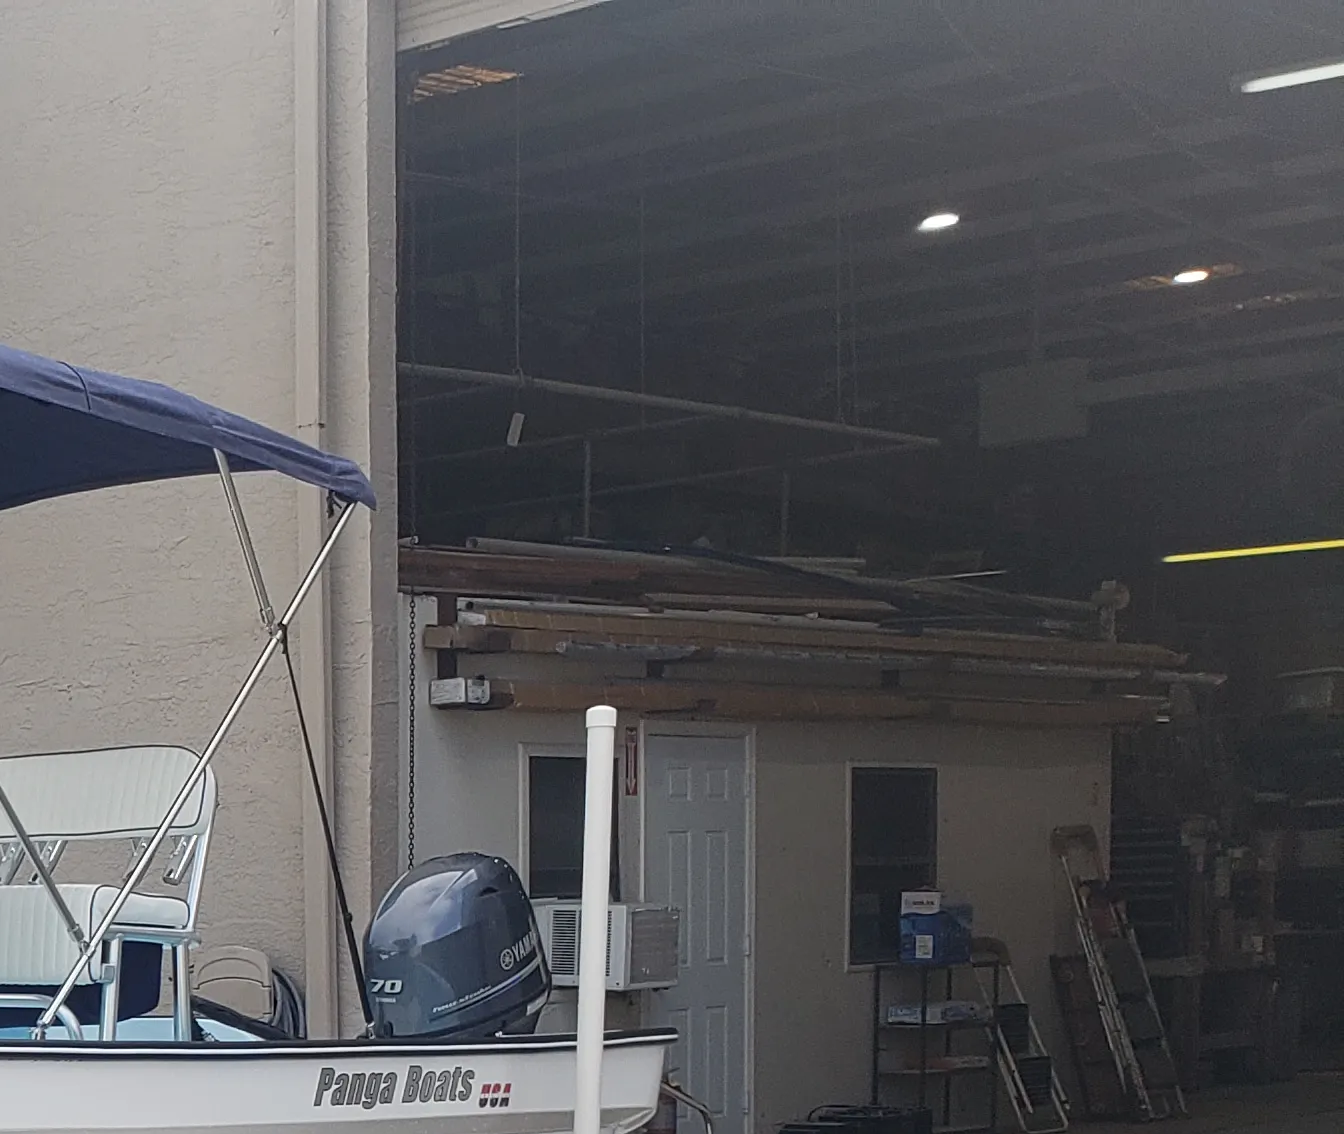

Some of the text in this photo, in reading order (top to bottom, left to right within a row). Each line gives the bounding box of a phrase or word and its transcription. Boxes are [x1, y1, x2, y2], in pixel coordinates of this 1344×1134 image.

[370, 979, 403, 994] 70
[313, 1067, 398, 1109] Panga
[402, 1065, 475, 1104] Boats
